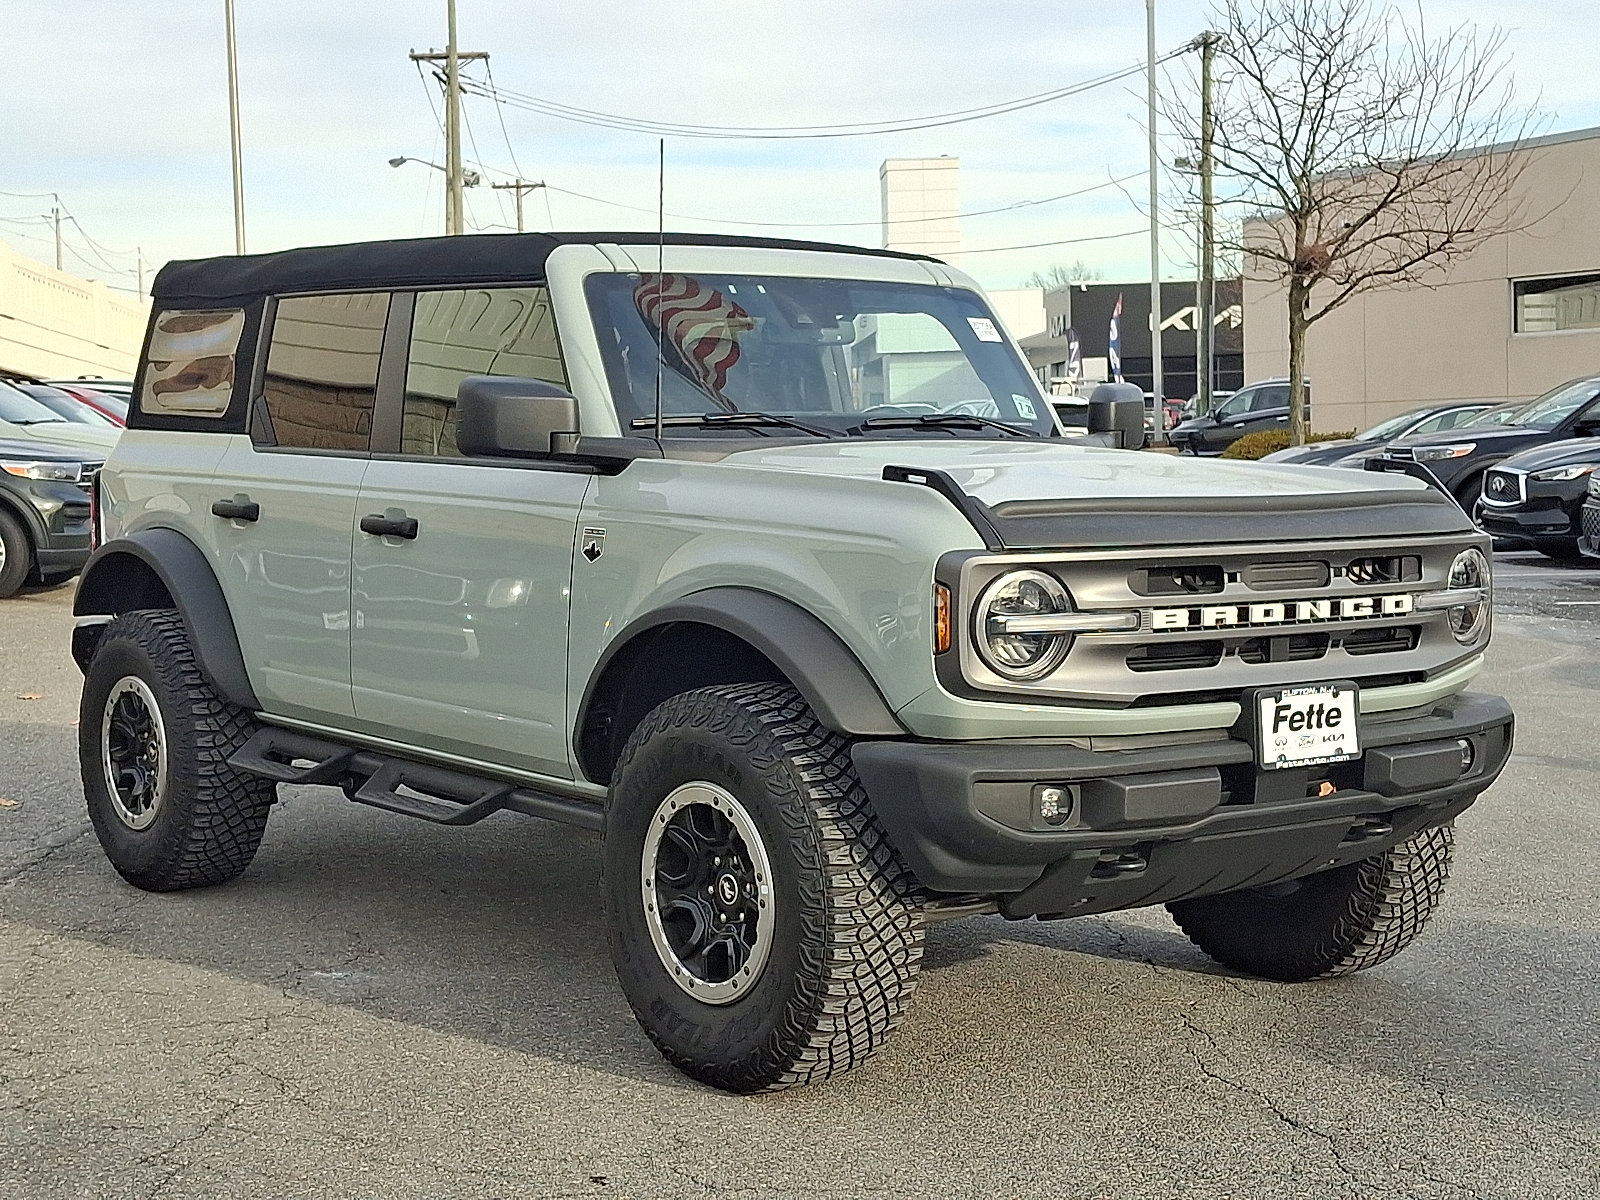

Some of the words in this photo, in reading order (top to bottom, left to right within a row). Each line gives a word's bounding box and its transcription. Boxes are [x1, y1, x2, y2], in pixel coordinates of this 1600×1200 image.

[1151, 594, 1413, 630] BRONCO
[1273, 703, 1342, 734] Fette
[1323, 733, 1345, 742] KIA
[1276, 755, 1349, 769] FetteAuto.com
